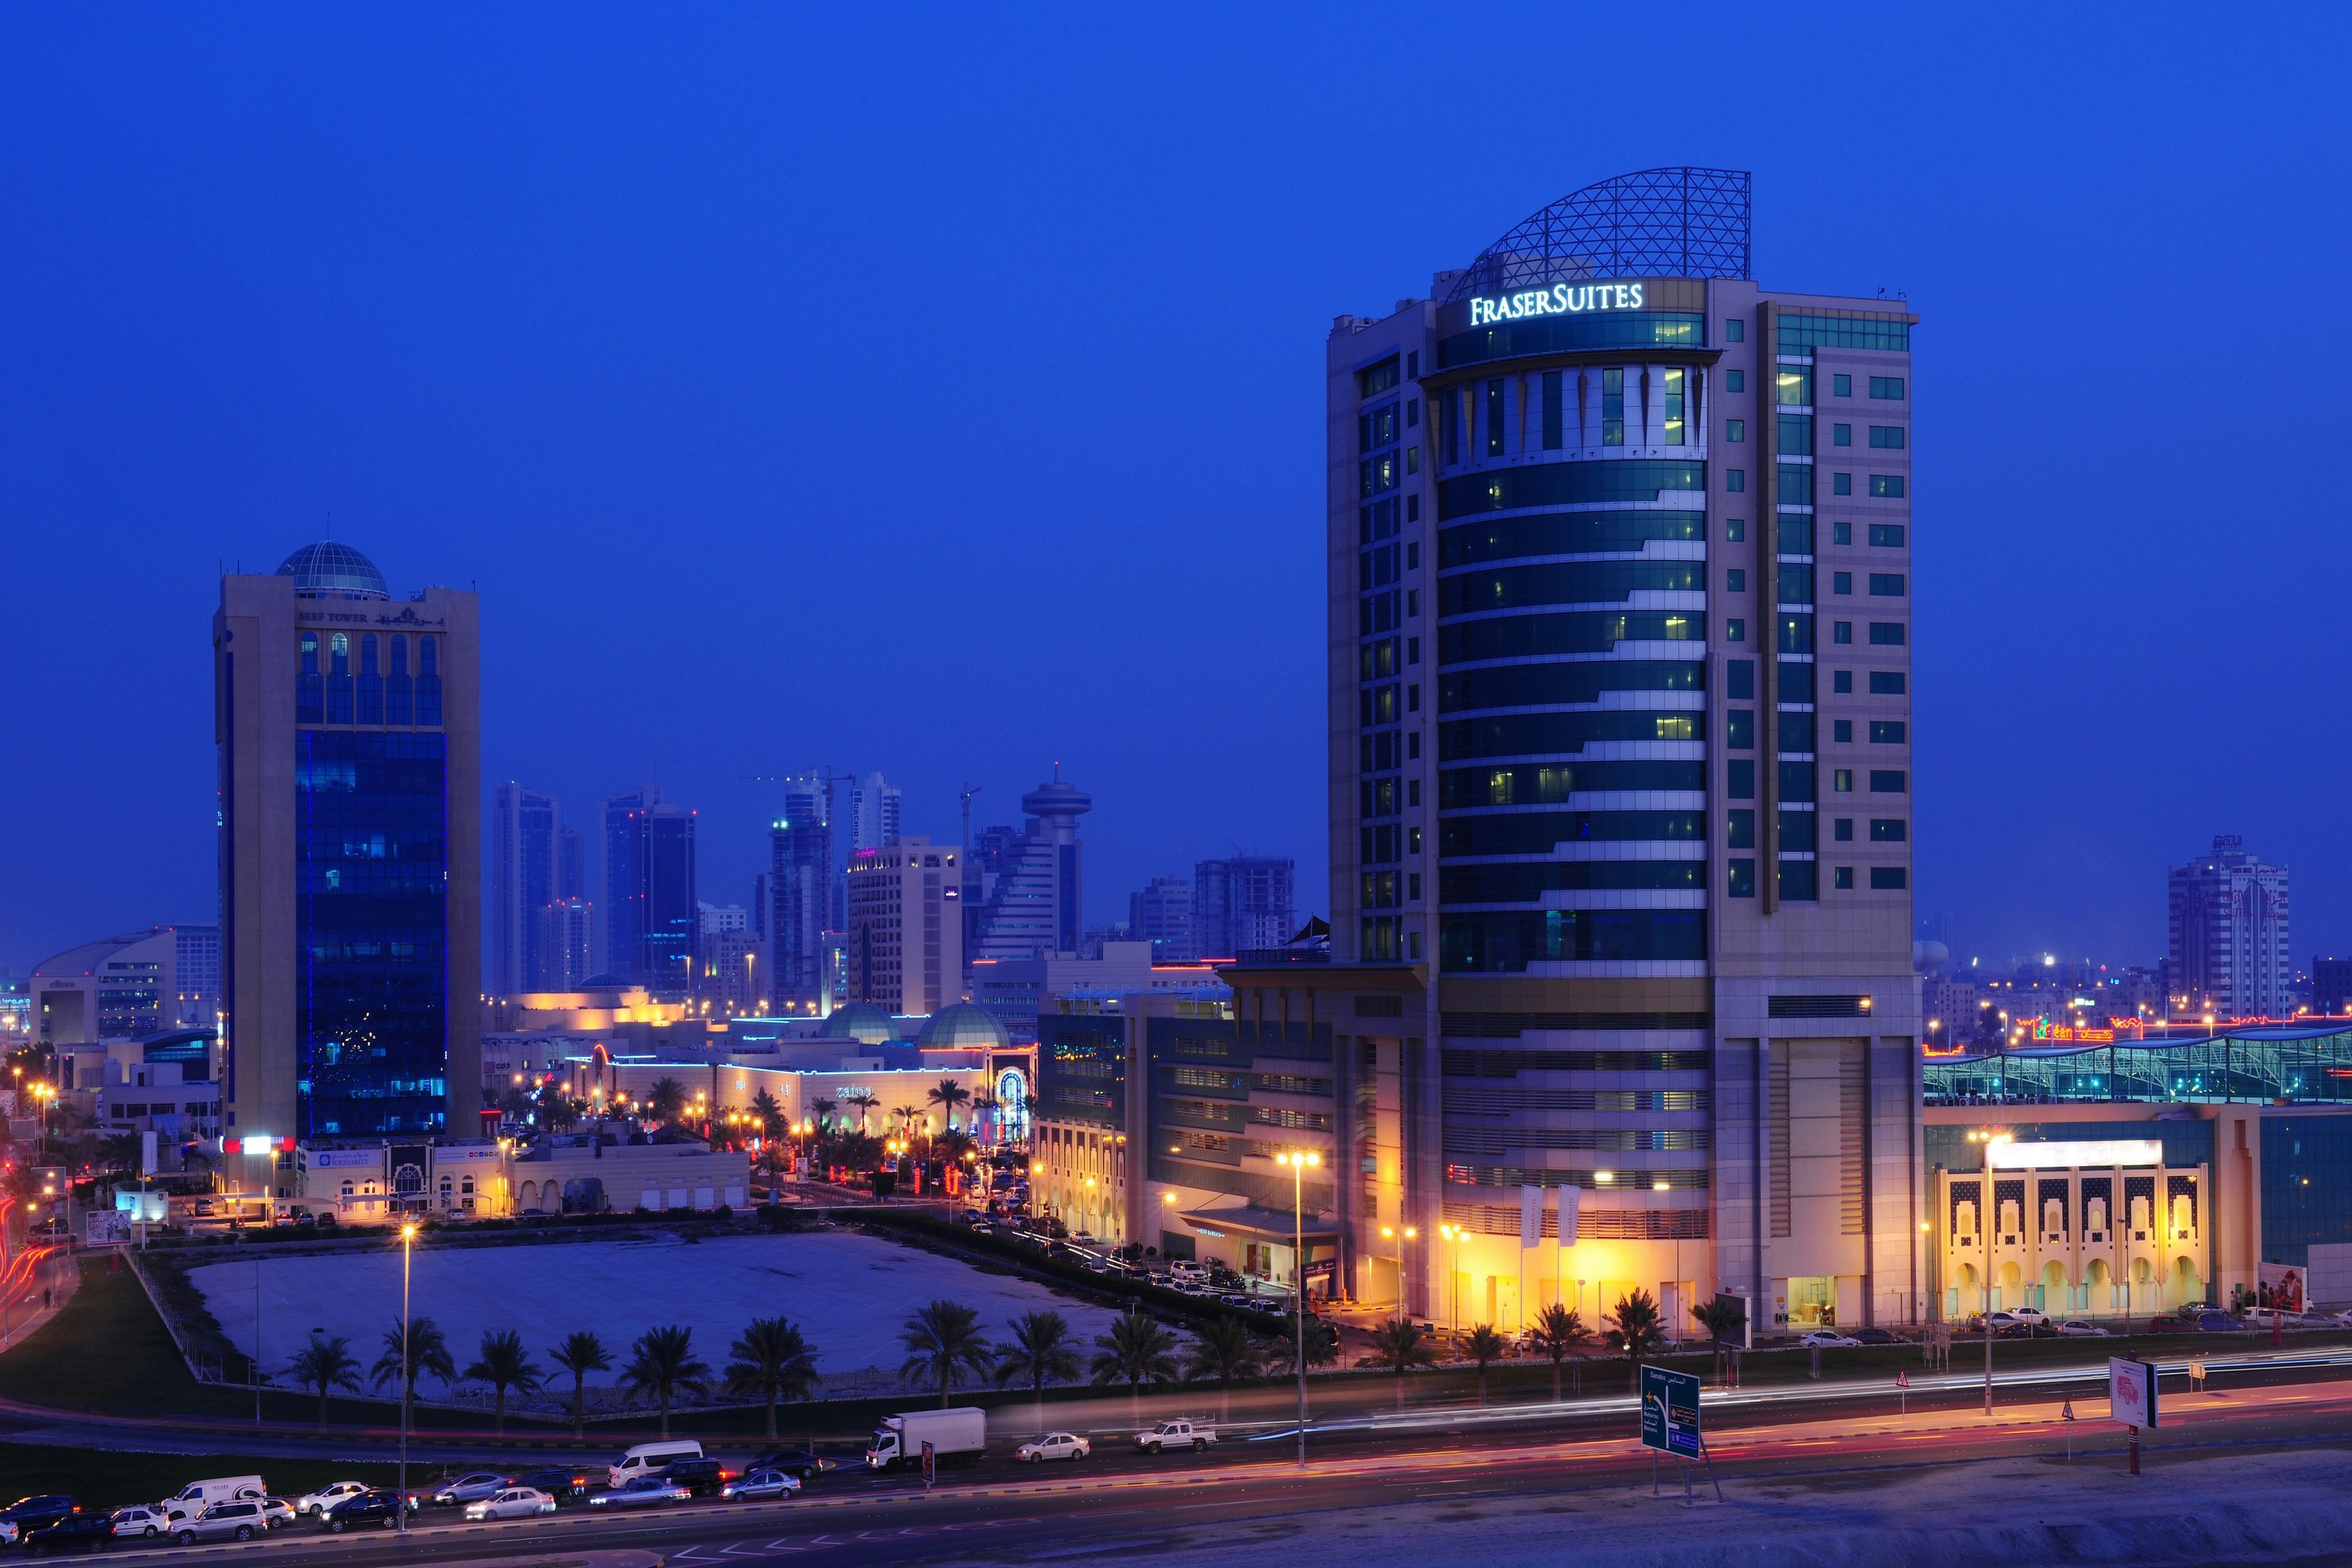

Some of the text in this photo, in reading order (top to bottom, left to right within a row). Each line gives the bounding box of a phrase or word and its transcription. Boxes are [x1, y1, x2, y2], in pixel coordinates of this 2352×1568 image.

[299, 612, 368, 622] SEEF TOWER
[835, 1083, 873, 1098] zaina
